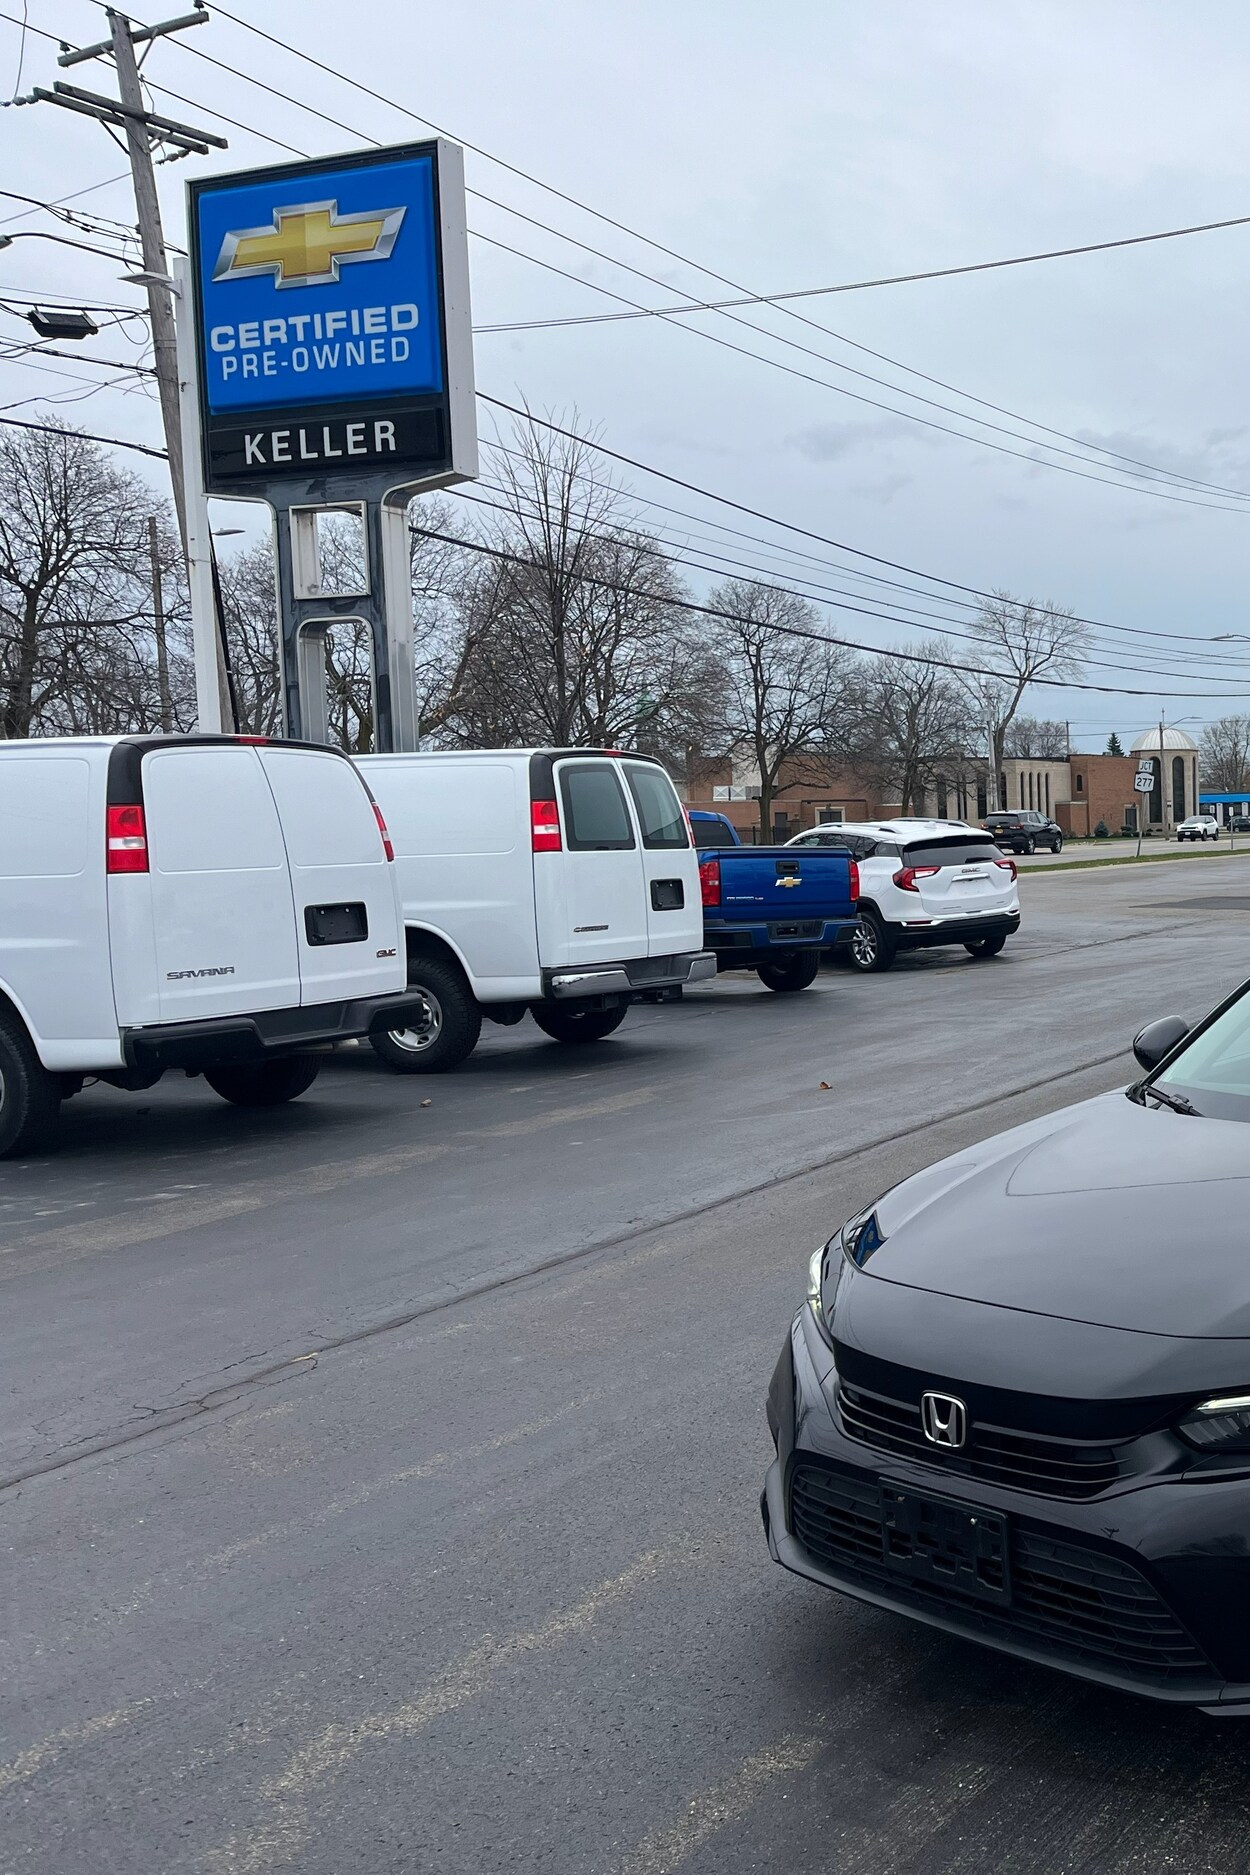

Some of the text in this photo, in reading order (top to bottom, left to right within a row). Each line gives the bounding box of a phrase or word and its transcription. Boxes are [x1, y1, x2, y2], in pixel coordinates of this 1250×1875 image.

[210, 303, 419, 352] CERTIFIED
[222, 336, 410, 381] PRE-OWNED
[244, 420, 397, 465] KELLER
[1140, 761, 1151, 770] JCT
[1136, 777, 1153, 787] 277
[376, 949, 396, 958] GMC
[166, 966, 235, 980] SAVANA
